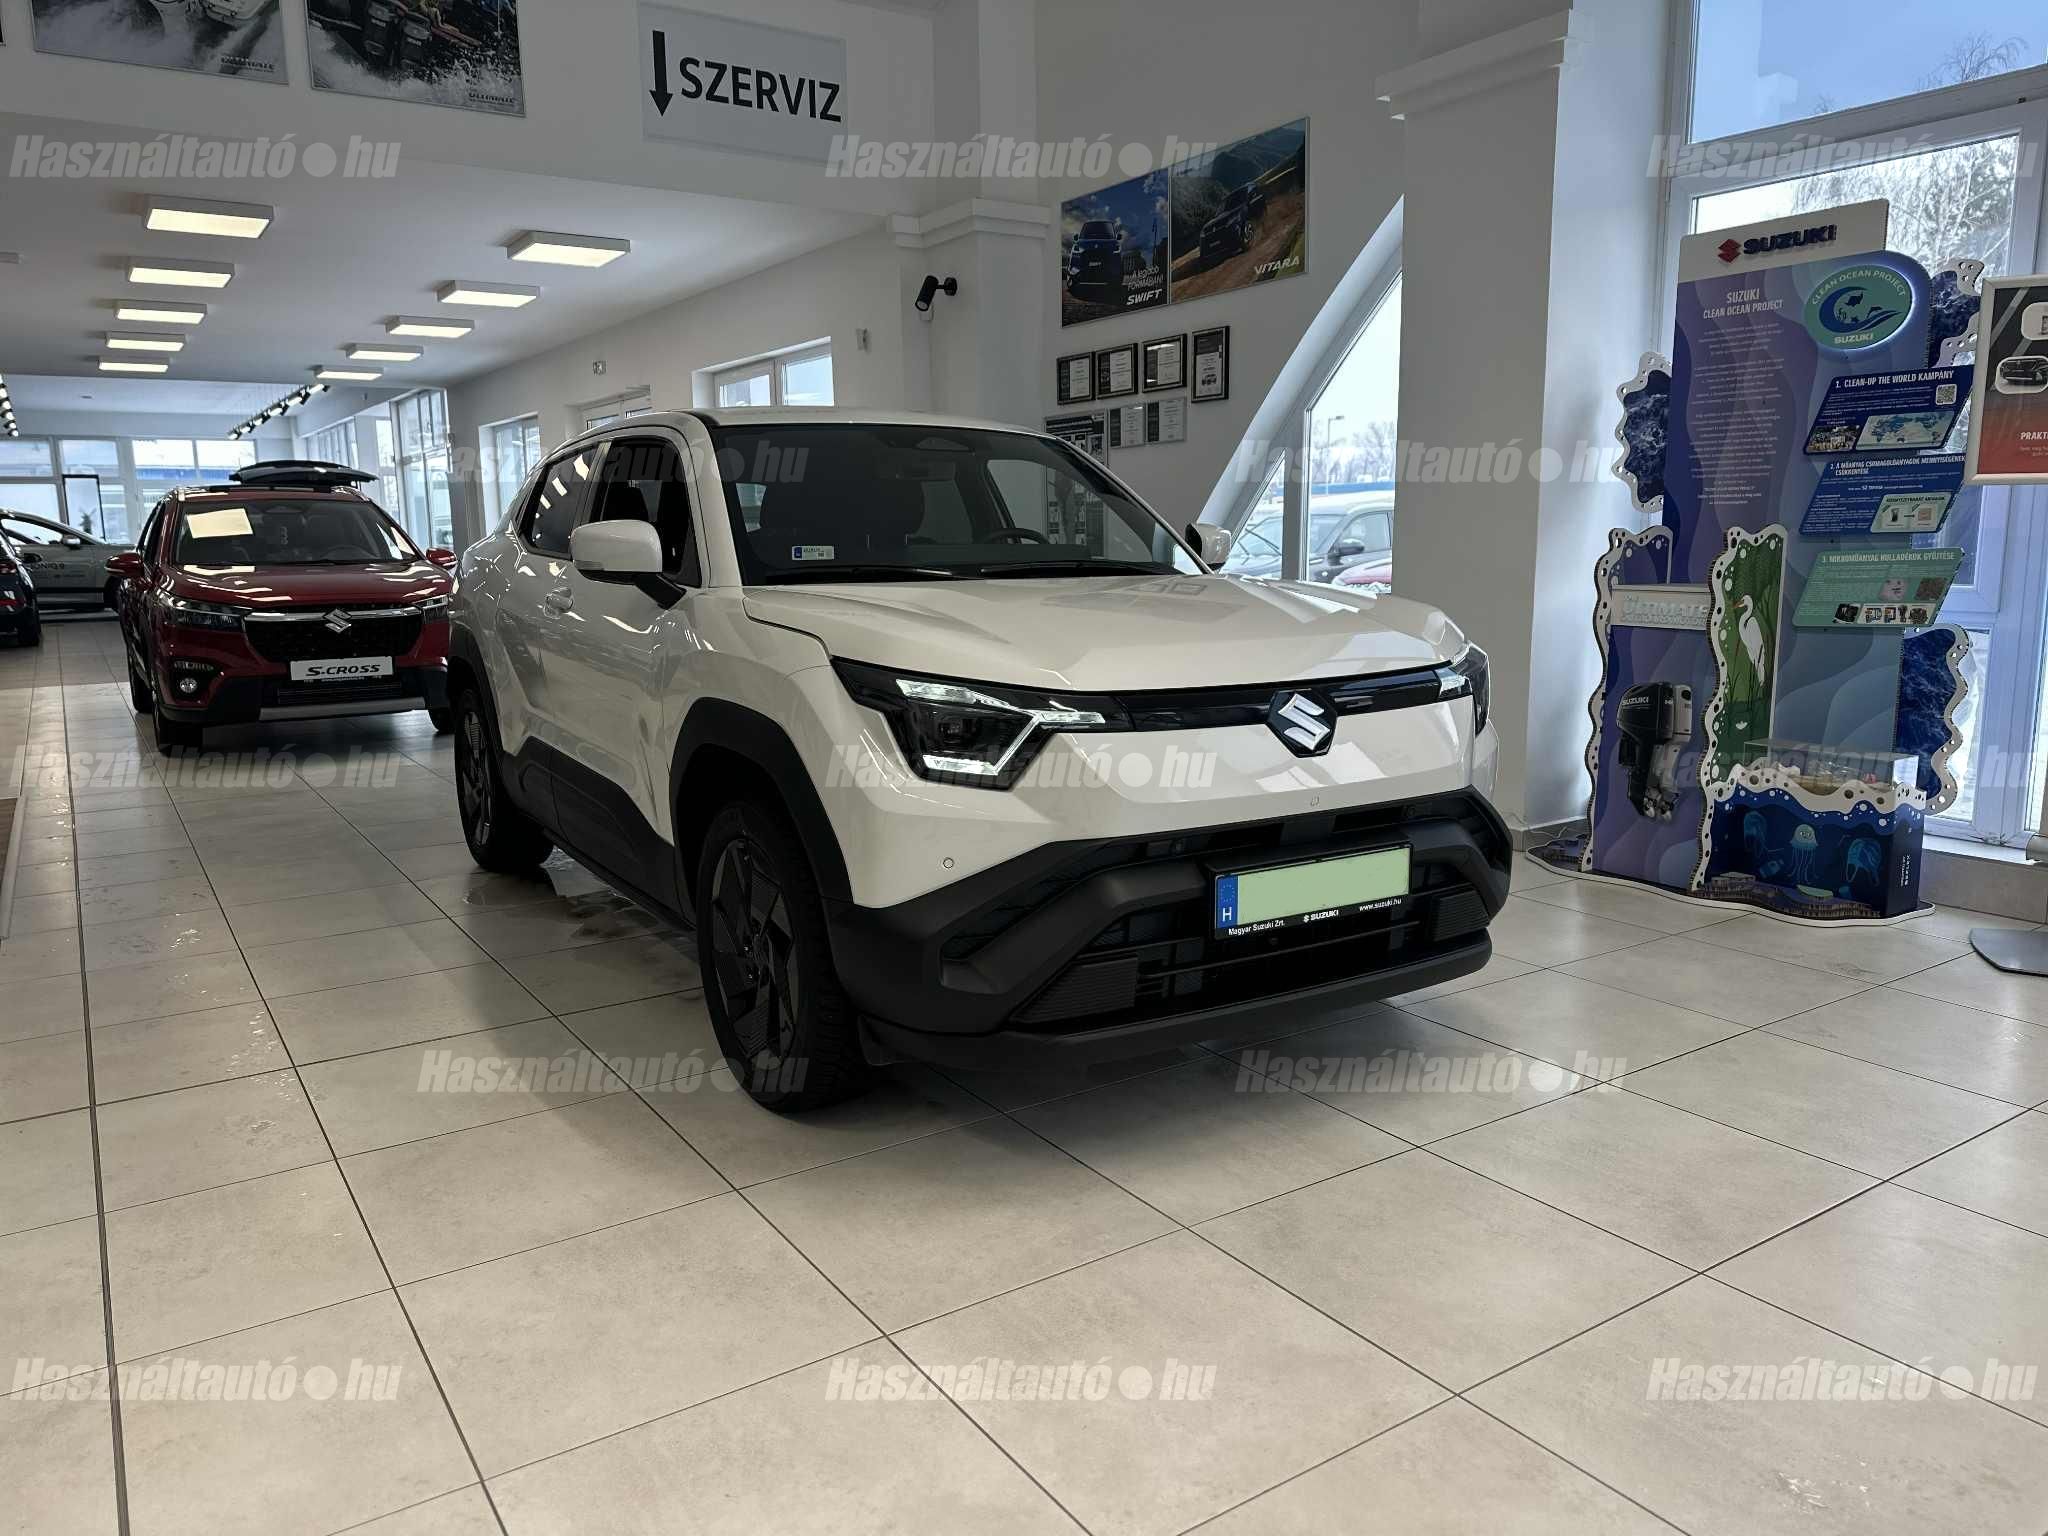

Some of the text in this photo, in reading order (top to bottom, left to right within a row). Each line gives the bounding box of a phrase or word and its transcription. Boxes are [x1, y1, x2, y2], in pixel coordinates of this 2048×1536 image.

[679, 56, 842, 123] SZERVIZ
[1743, 224, 1838, 255] SUZUKI
[1254, 256, 1300, 275] VITARA
[1126, 288, 1162, 305] SWIFT
[1726, 288, 1761, 304] SUZUKI
[1812, 270, 1906, 305] CLEAN OCEAN PROJECT
[1703, 298, 1784, 320] CLEAN OCEAN PROJECT
[1834, 333, 1874, 345] SUZUKI
[1844, 378, 1877, 388] CLEAN-UP
[1879, 376, 1891, 385] THE
[1892, 373, 1917, 383] WORLD
[2020, 431, 2048, 440] PRAKT
[1222, 906, 1232, 922] H
[1228, 898, 1402, 936] Magyar Suzuki Zrt. SUZUKI www.suzuki.hu
